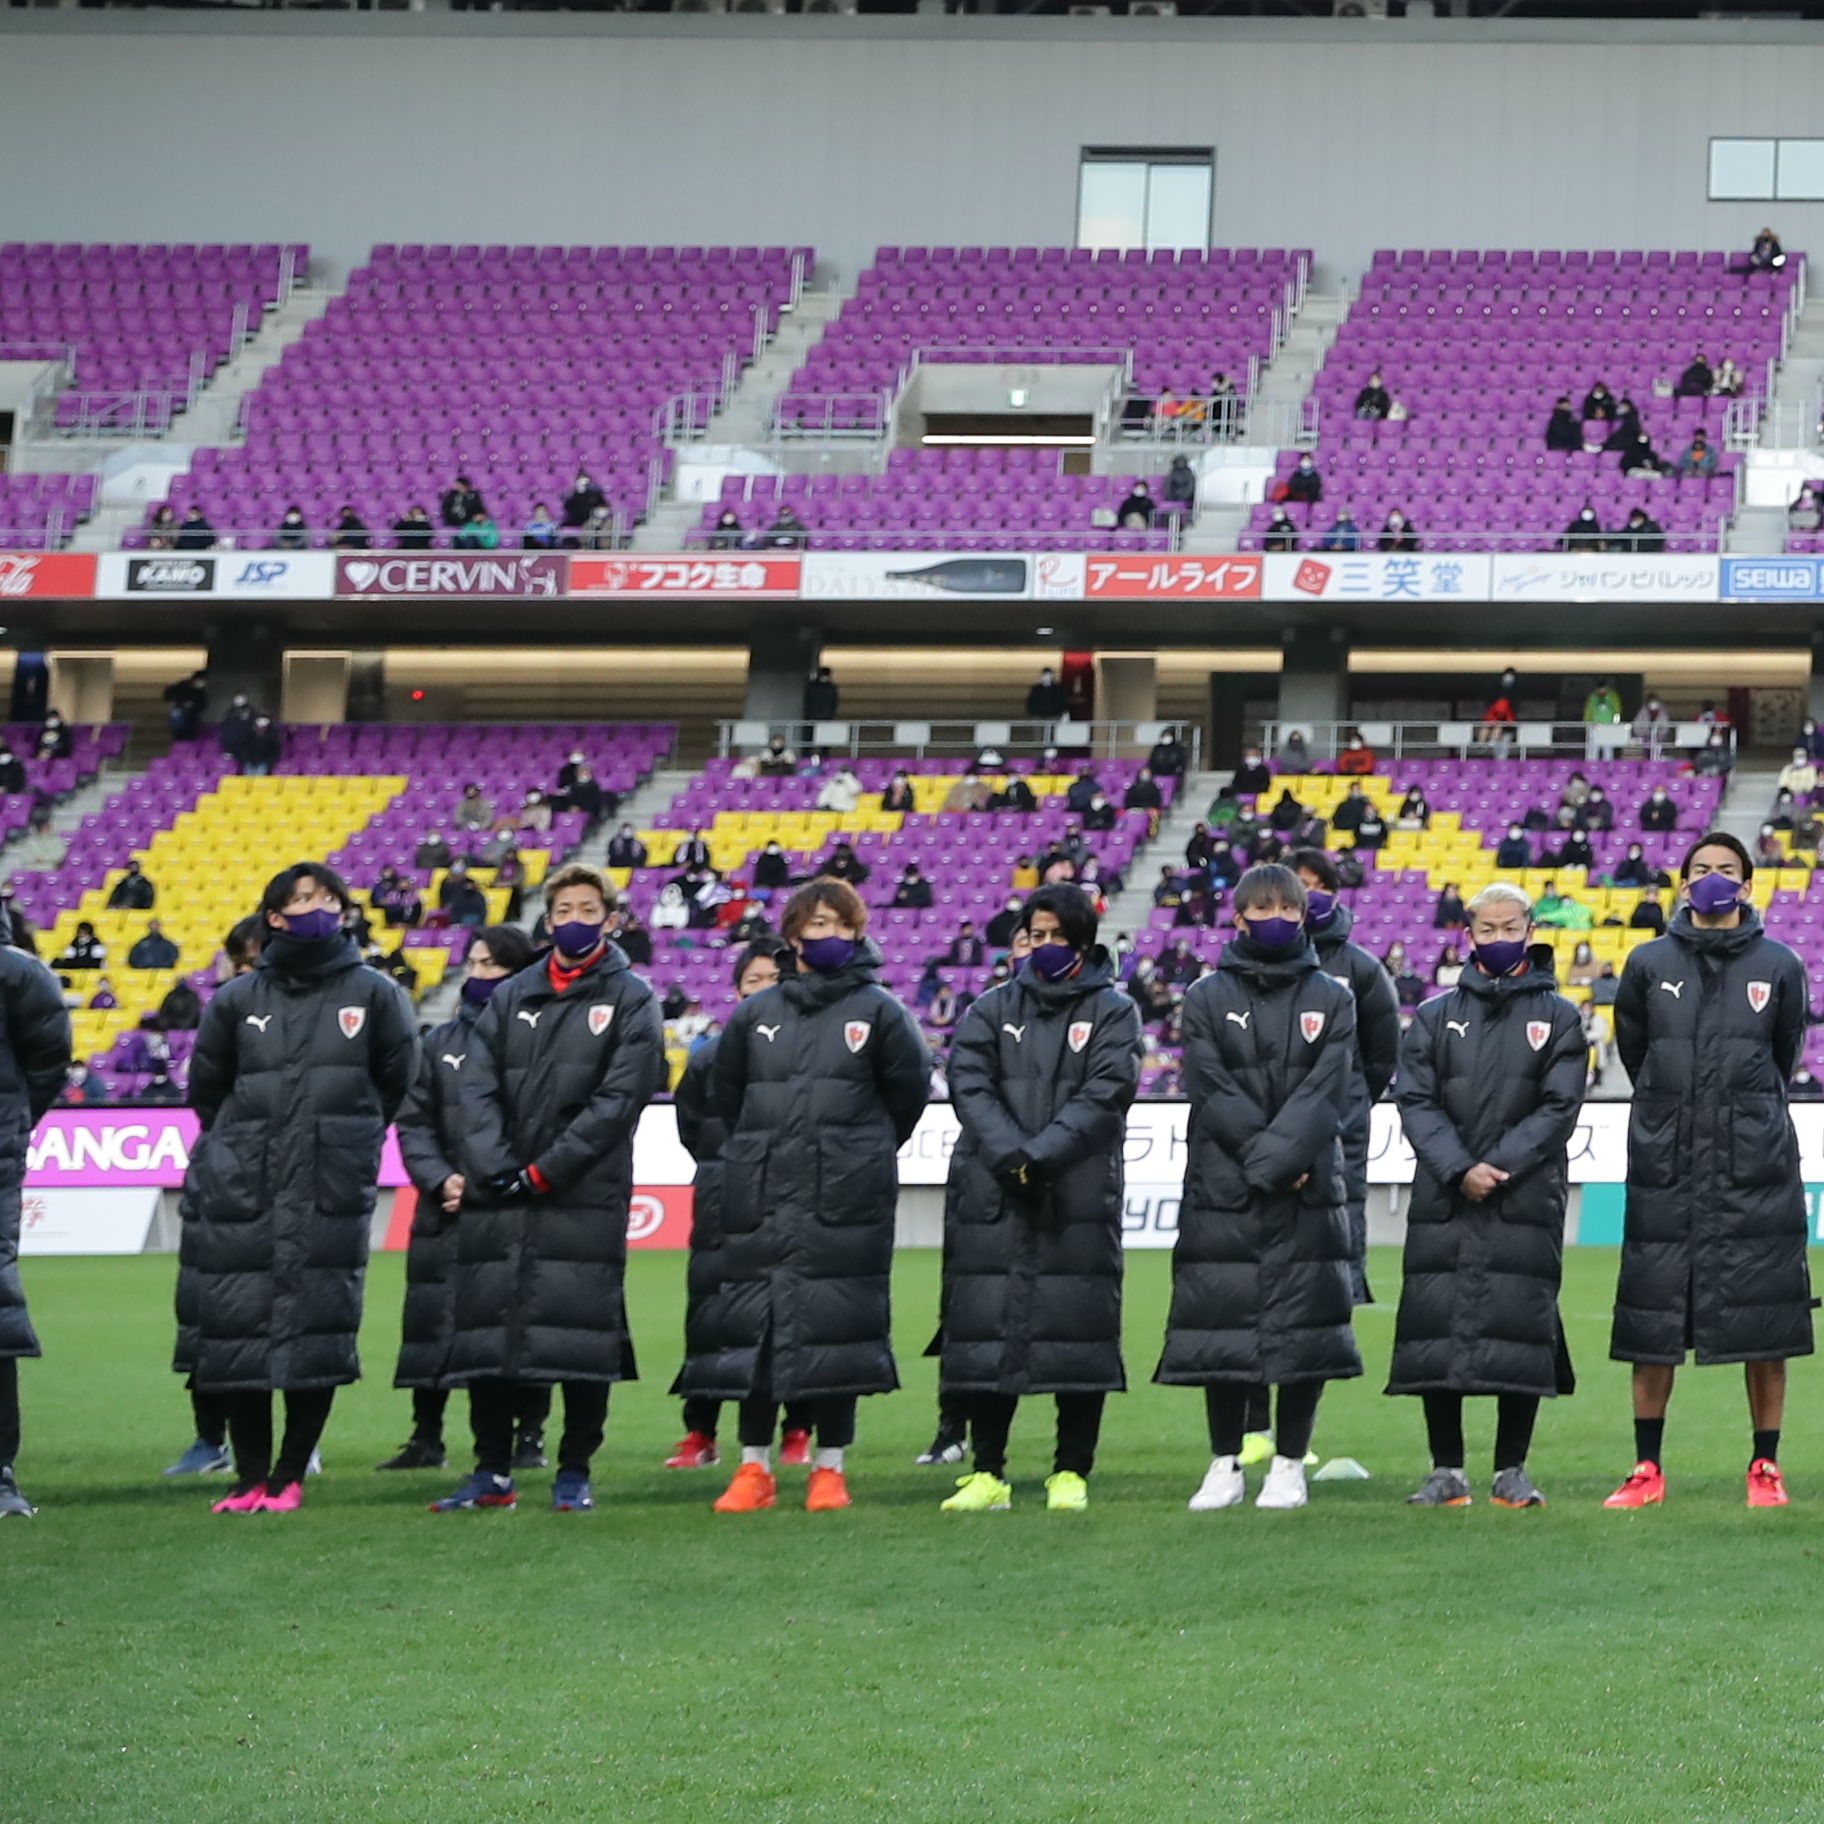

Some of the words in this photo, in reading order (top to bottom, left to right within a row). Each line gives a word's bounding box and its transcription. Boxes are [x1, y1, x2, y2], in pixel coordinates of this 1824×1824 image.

[237, 561, 289, 584] JSP
[379, 560, 517, 592] CERVIN
[639, 562, 767, 590] フコク生命
[1089, 561, 1257, 592] アールライフ
[1340, 559, 1463, 595] 三笑堂
